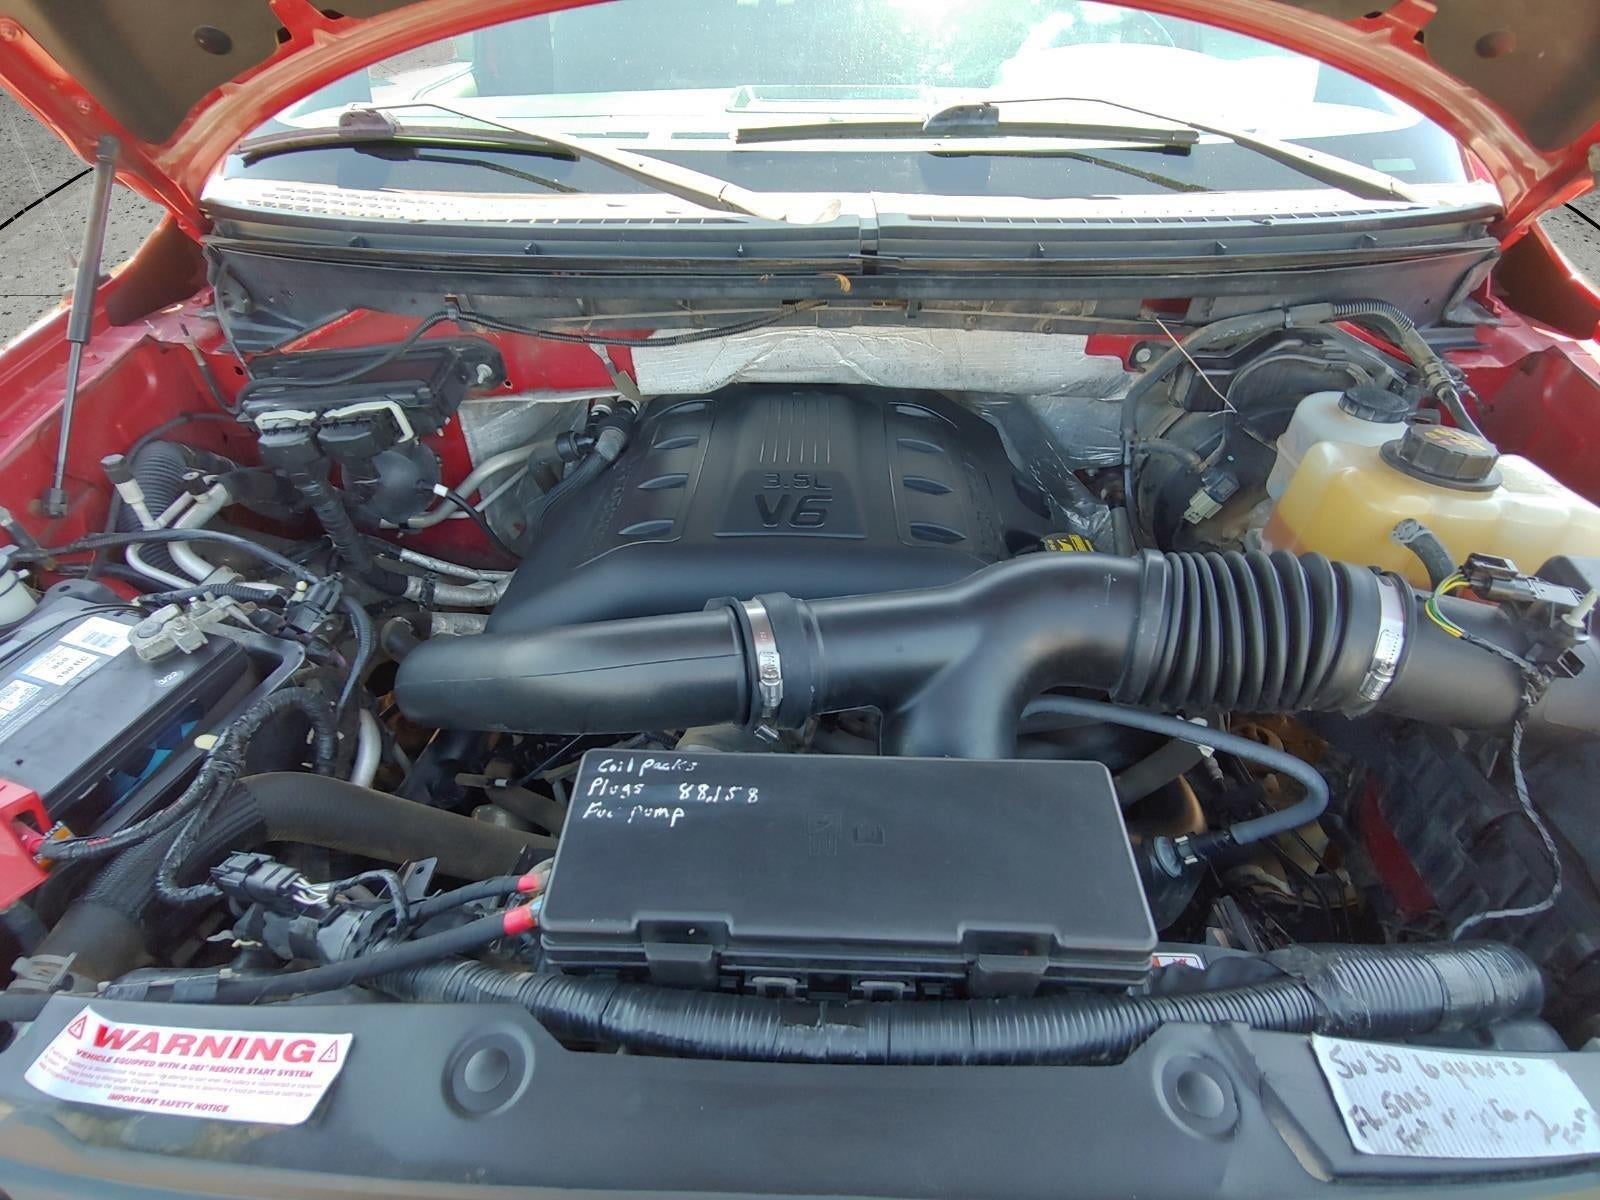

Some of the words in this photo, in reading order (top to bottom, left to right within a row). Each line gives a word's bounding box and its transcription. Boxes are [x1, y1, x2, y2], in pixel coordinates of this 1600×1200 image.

[763, 473, 832, 491] 3.5L
[755, 494, 832, 529] V6
[93, 1023, 316, 1063] WARNING
[75, 1048, 112, 1064] VEHICLE
[113, 1056, 156, 1068] EQUIPPED
[157, 1060, 180, 1070] WITH
[180, 1062, 188, 1071] A
[209, 1064, 245, 1075] REMOTE
[246, 1067, 276, 1077] START
[277, 1069, 314, 1079] SYSTEM
[107, 1093, 160, 1106] IMPORTANT
[159, 1099, 194, 1110] SAFETY
[193, 1102, 230, 1113] NOTICE
